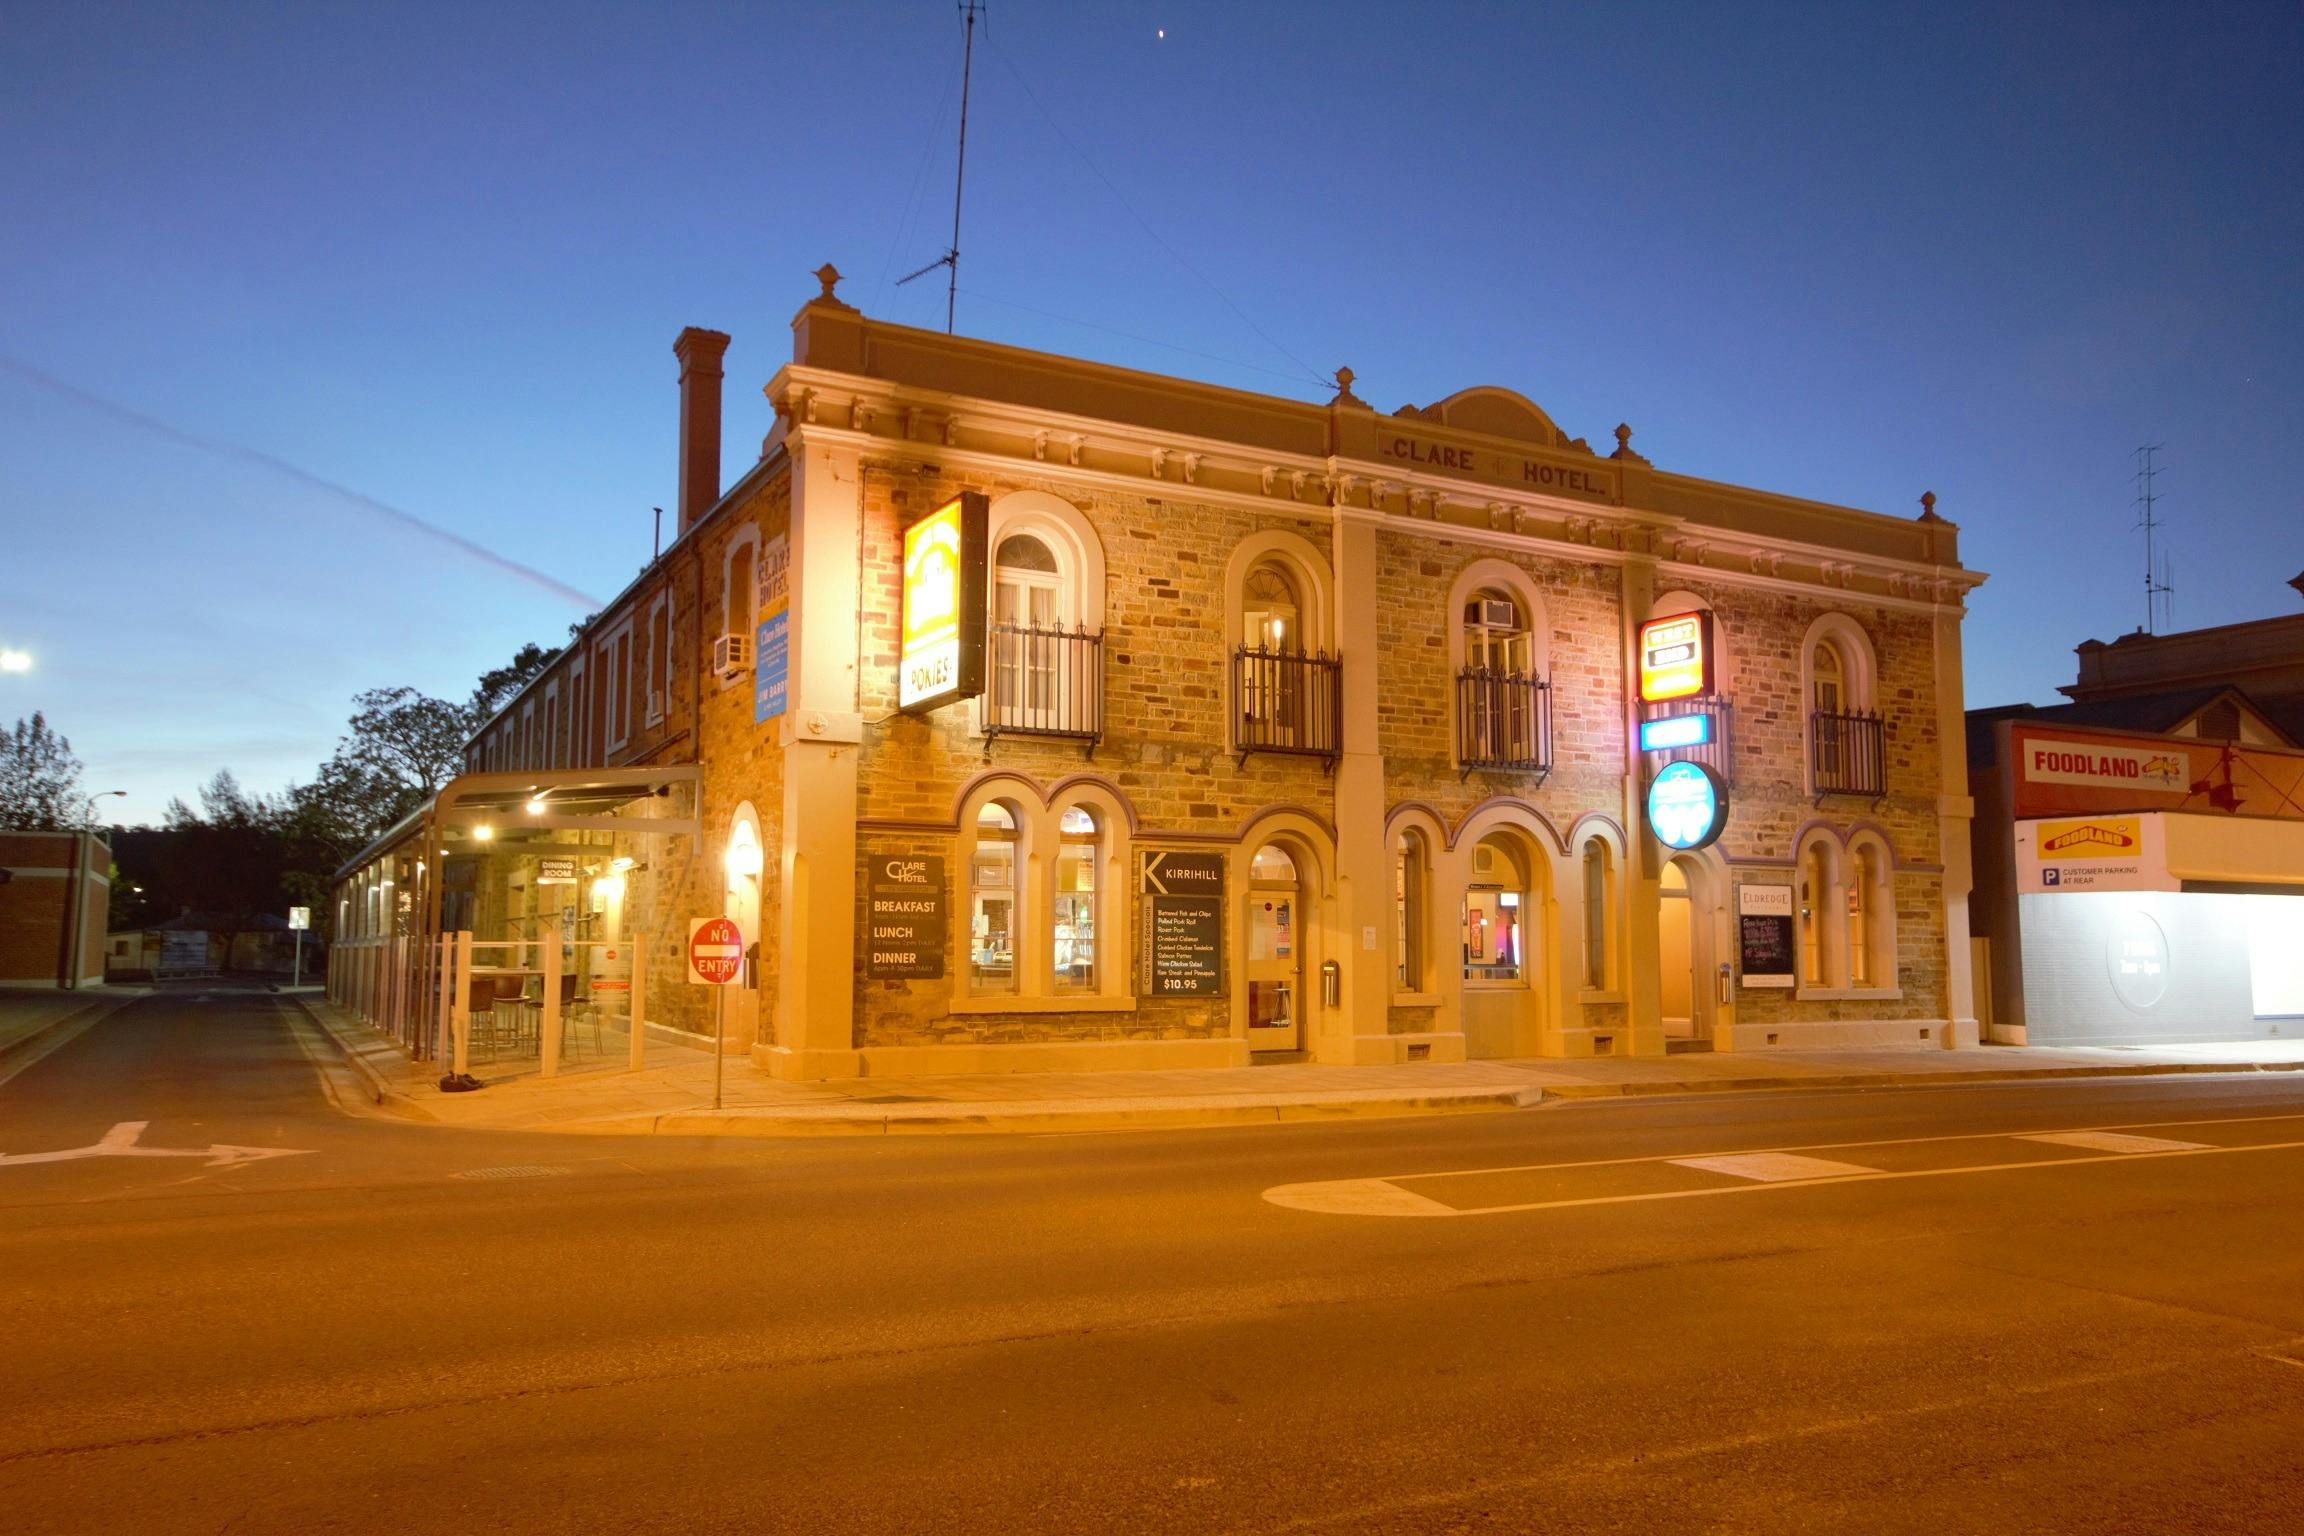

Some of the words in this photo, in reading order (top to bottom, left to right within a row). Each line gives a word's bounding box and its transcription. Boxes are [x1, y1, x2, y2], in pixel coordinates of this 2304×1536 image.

[1392, 437, 1475, 472] CLARE
[1523, 460, 1599, 494] HOTEL
[911, 656, 949, 692] POKIES
[2034, 751, 2139, 779] FOODLAND
[2054, 826, 2124, 850] FOODLAND
[541, 862, 574, 870] DINING
[885, 861, 927, 879] CLARE
[543, 869, 572, 877] ROOM
[898, 868, 928, 883] HOTEL
[1166, 868, 1218, 880] KIRRIHILL
[2045, 870, 2057, 885] P
[2062, 867, 2103, 876] CUSTOMER
[2104, 866, 2138, 875] PARKING
[2073, 877, 2094, 885] REAR
[1743, 893, 1789, 905] ELDREDGE
[874, 900, 936, 912] BREAKFAST
[711, 929, 729, 942] NO
[873, 927, 913, 938] LUNCH
[873, 953, 917, 964] DINNER
[698, 960, 736, 973] ENTRY
[1163, 978, 1198, 990] $10.95
